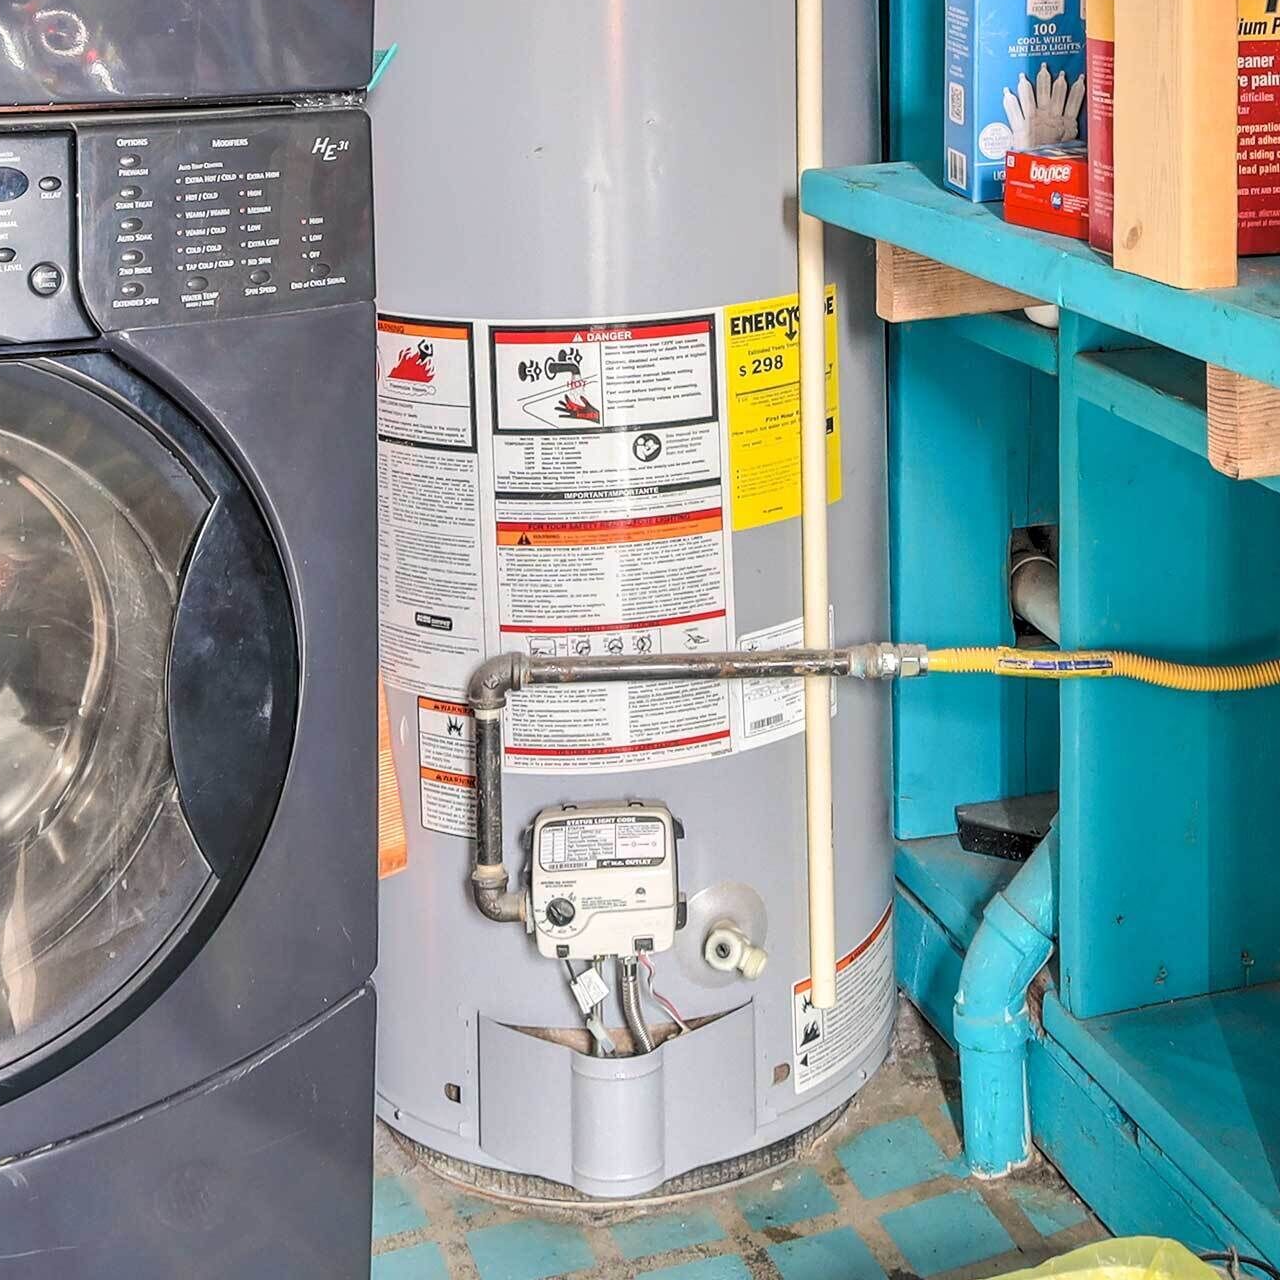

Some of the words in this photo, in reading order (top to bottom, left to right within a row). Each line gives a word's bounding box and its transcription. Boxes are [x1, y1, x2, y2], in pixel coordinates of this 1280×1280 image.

[1033, 23, 1056, 35] 100
[1017, 36, 1041, 45] COOL
[1043, 35, 1073, 44] WHITE
[1008, 44, 1029, 54] MINI
[1030, 43, 1047, 52] LED
[1049, 42, 1081, 51] LIGHTS
[1240, 136, 1255, 146] and
[1030, 161, 1072, 183] bounce
[1239, 164, 1256, 174] lead
[1259, 162, 1280, 175] paint
[586, 331, 632, 342] DANGER
[752, 354, 784, 375] 298
